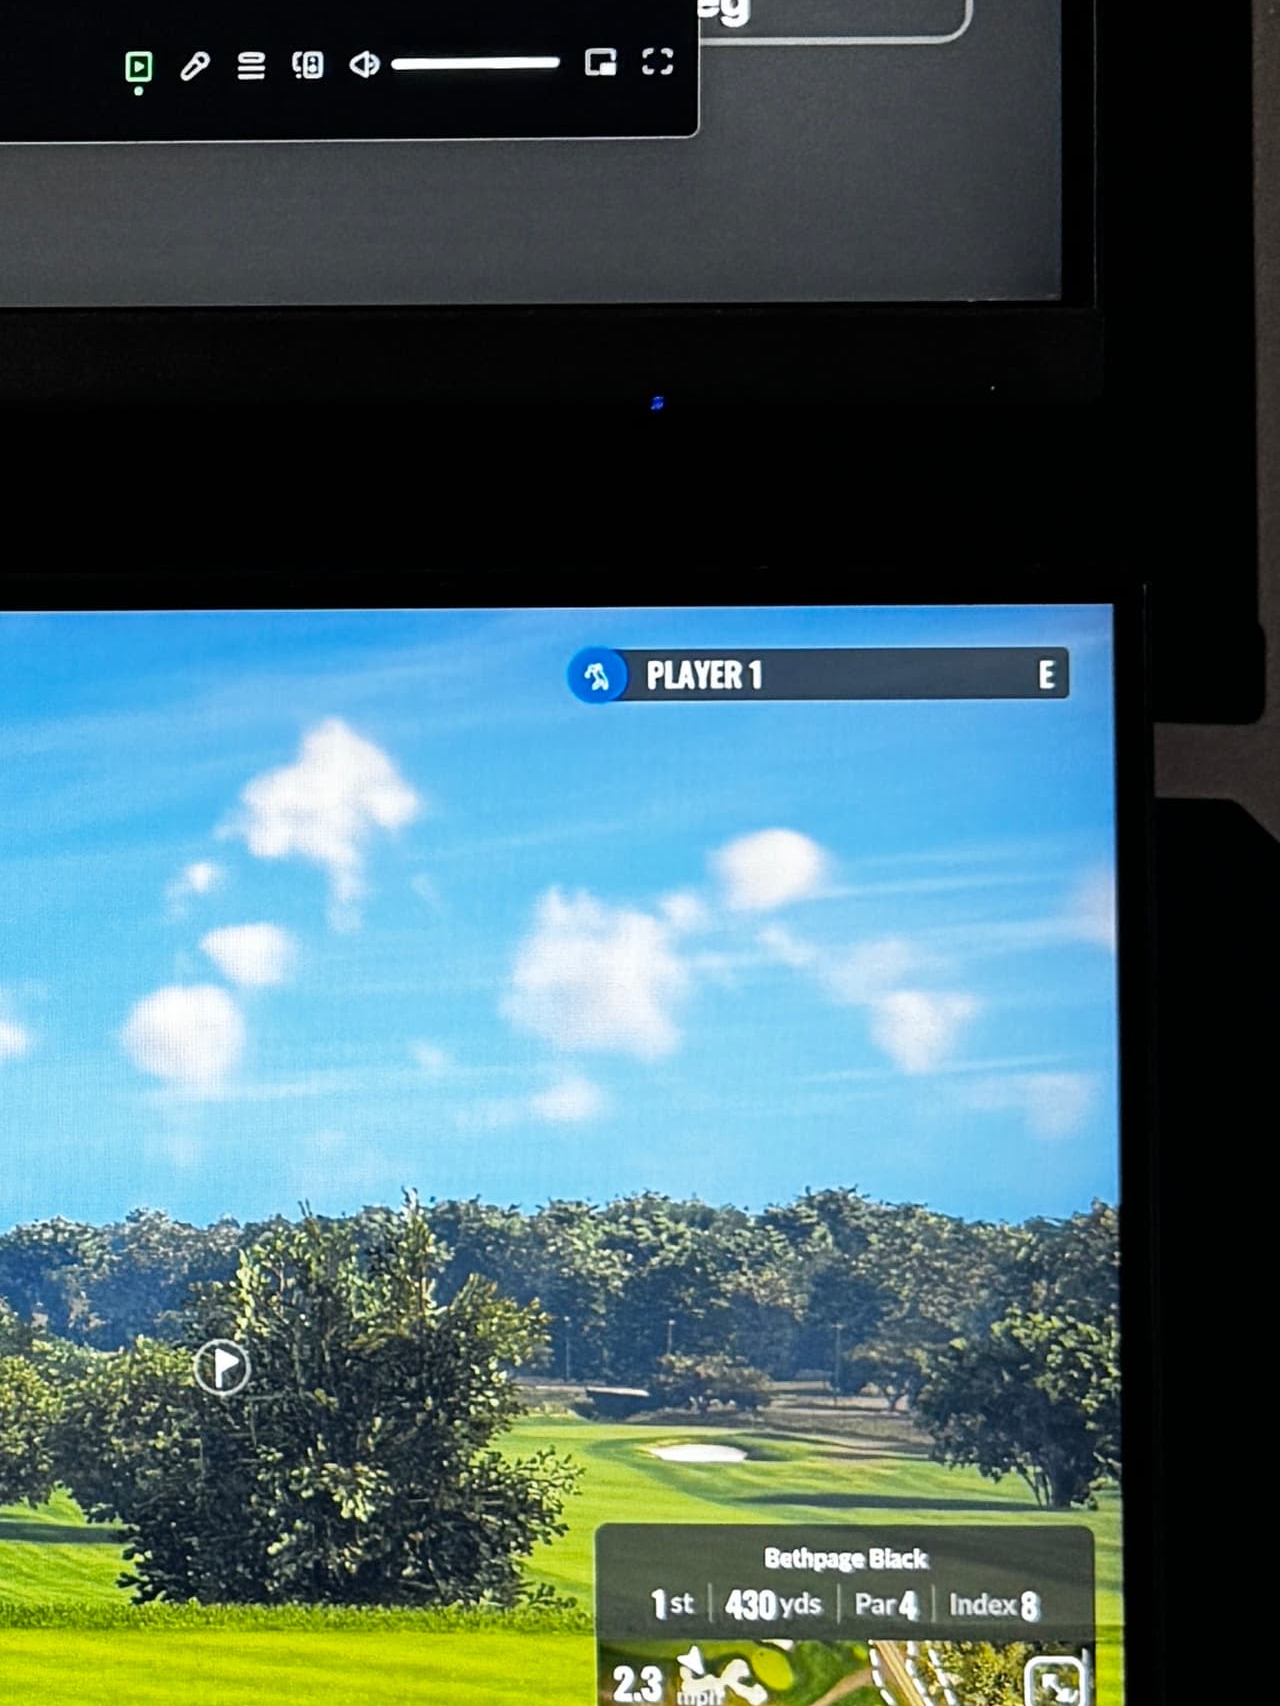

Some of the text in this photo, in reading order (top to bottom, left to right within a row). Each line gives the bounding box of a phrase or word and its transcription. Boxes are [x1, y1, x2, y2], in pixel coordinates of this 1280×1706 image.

[647, 660, 763, 690] PLAYER 1
[1039, 660, 1055, 689] E
[765, 1547, 928, 1573] Bethpage Black
[724, 1588, 822, 1620] 430 yds
[855, 1590, 918, 1621] Par 4
[950, 1592, 1017, 1617] Index
[613, 1664, 663, 1703] 2.3
